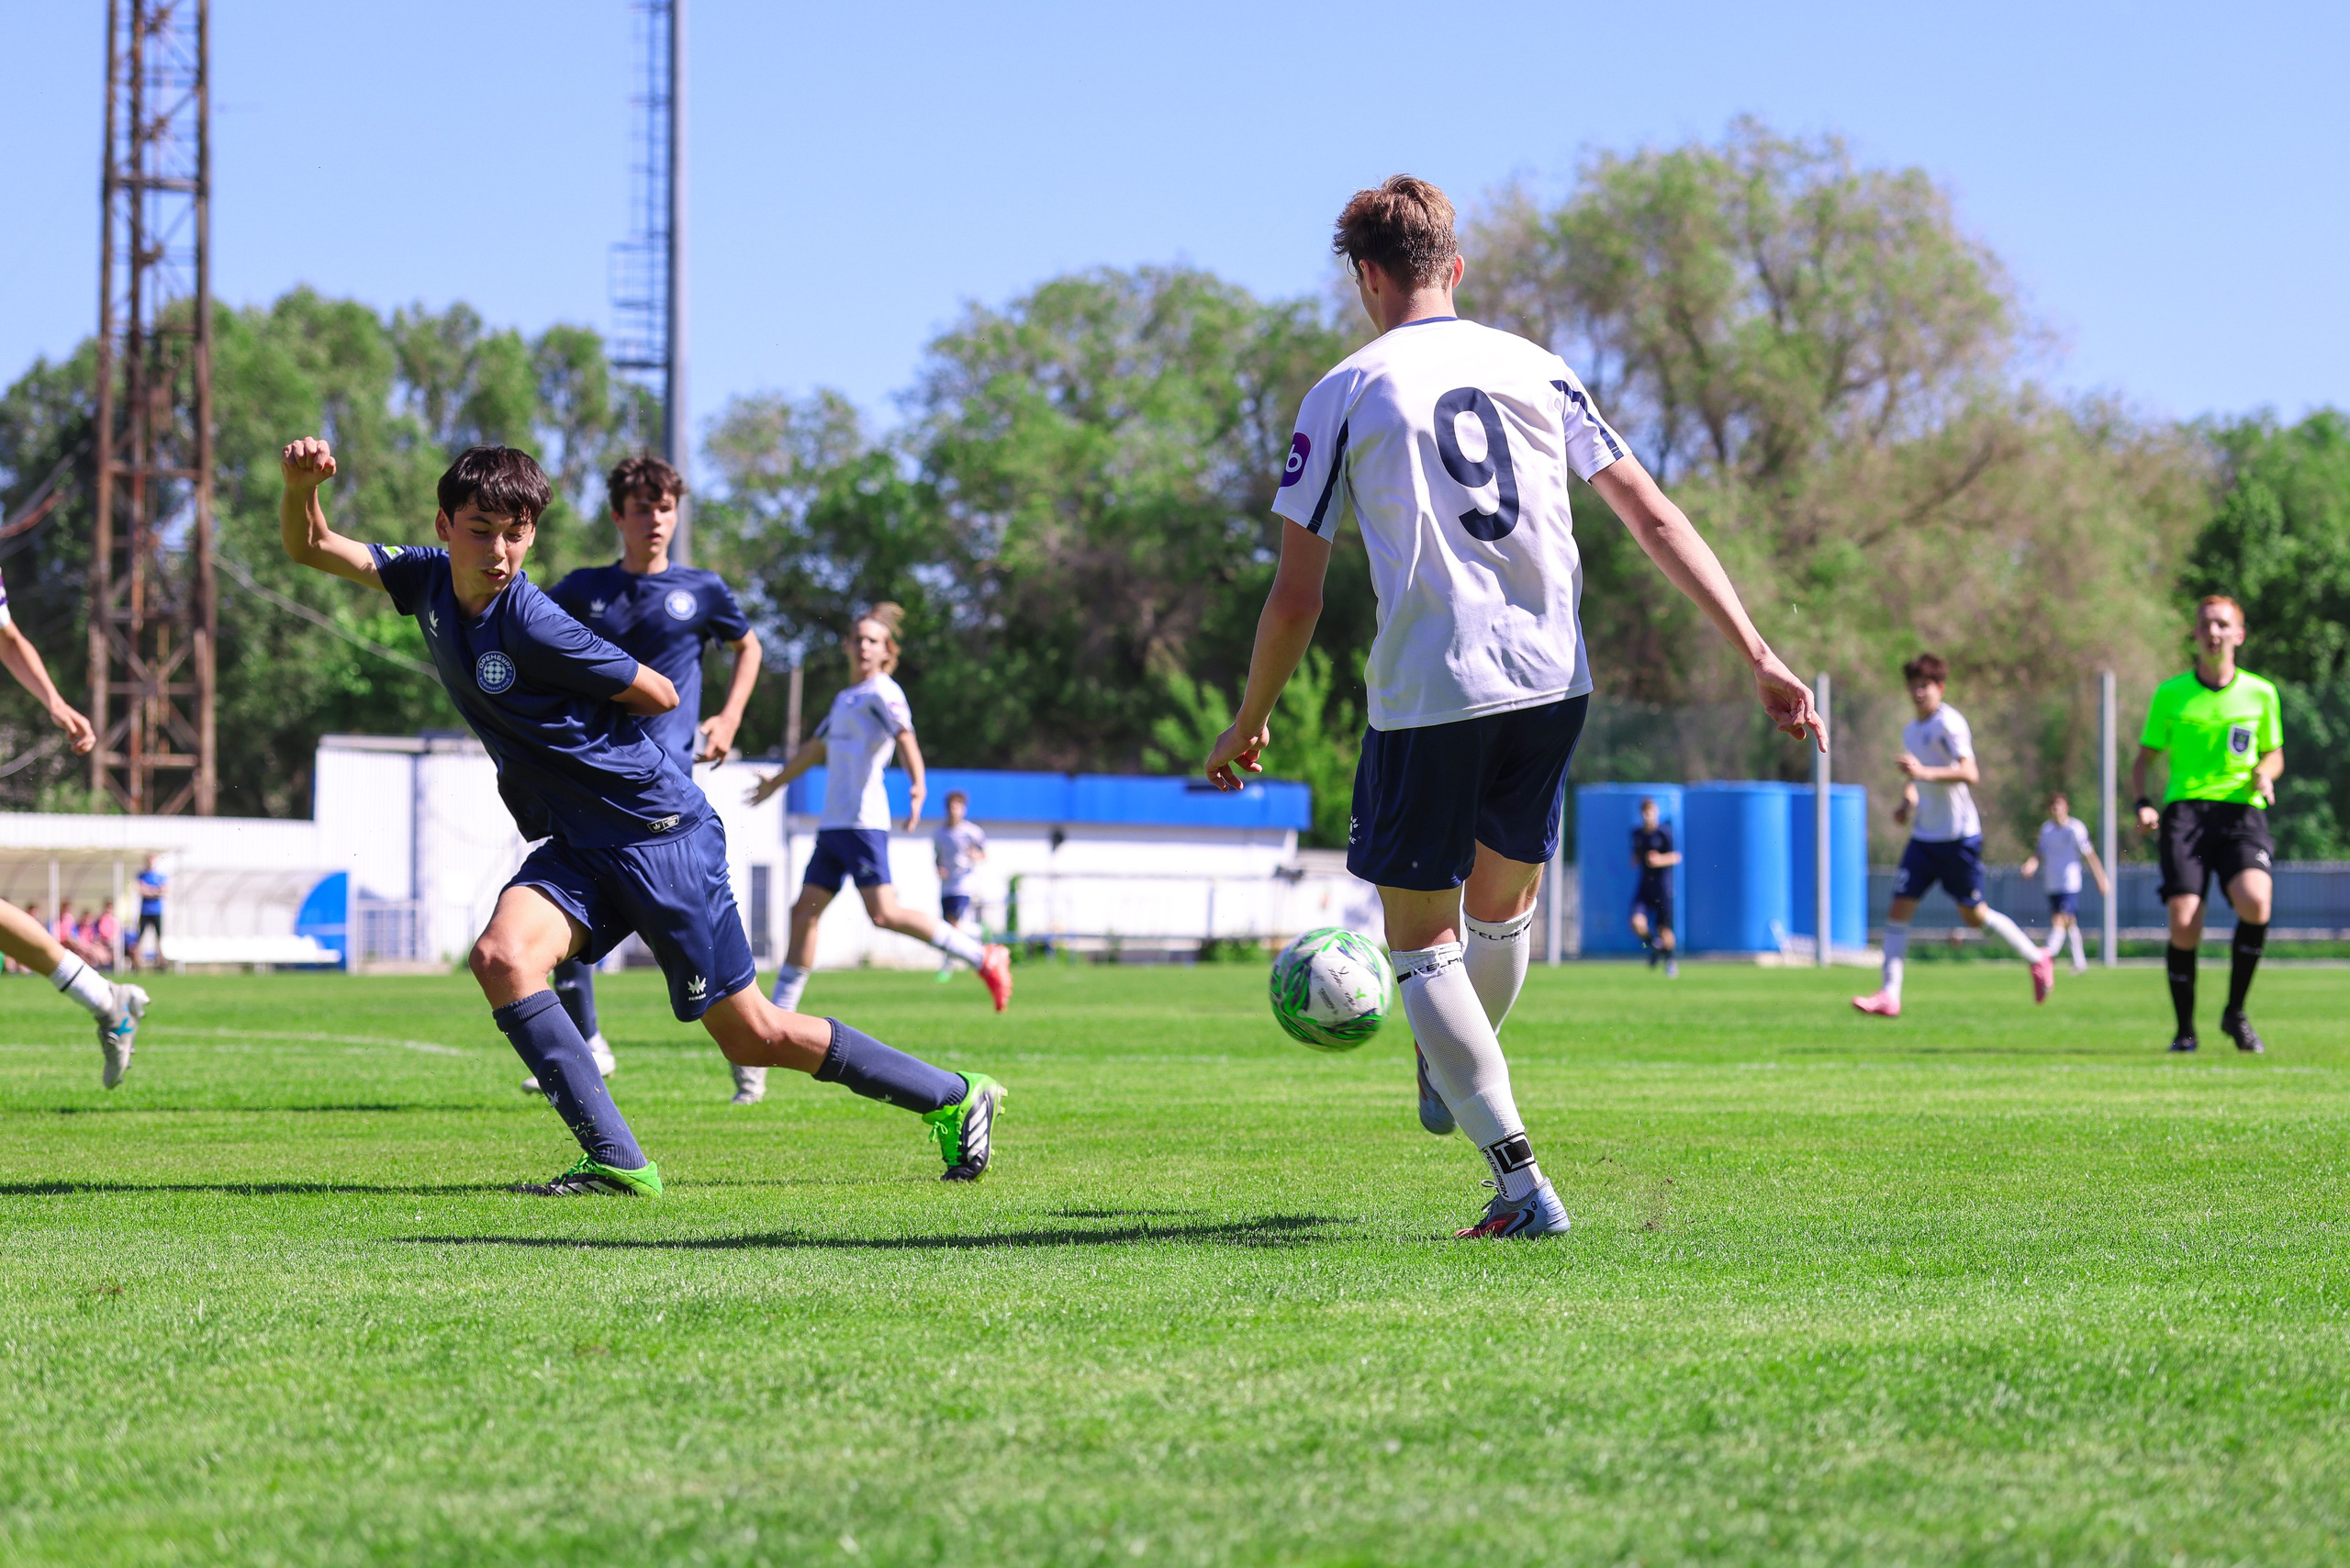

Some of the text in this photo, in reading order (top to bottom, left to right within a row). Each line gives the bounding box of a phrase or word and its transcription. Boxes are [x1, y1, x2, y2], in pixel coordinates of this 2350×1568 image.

[1434, 386, 1520, 542] 9
[478, 655, 512, 671] ОРЕНБУРГ
[1414, 957, 1463, 975] KELM
[1482, 1148, 1509, 1199] PEDESIGN
